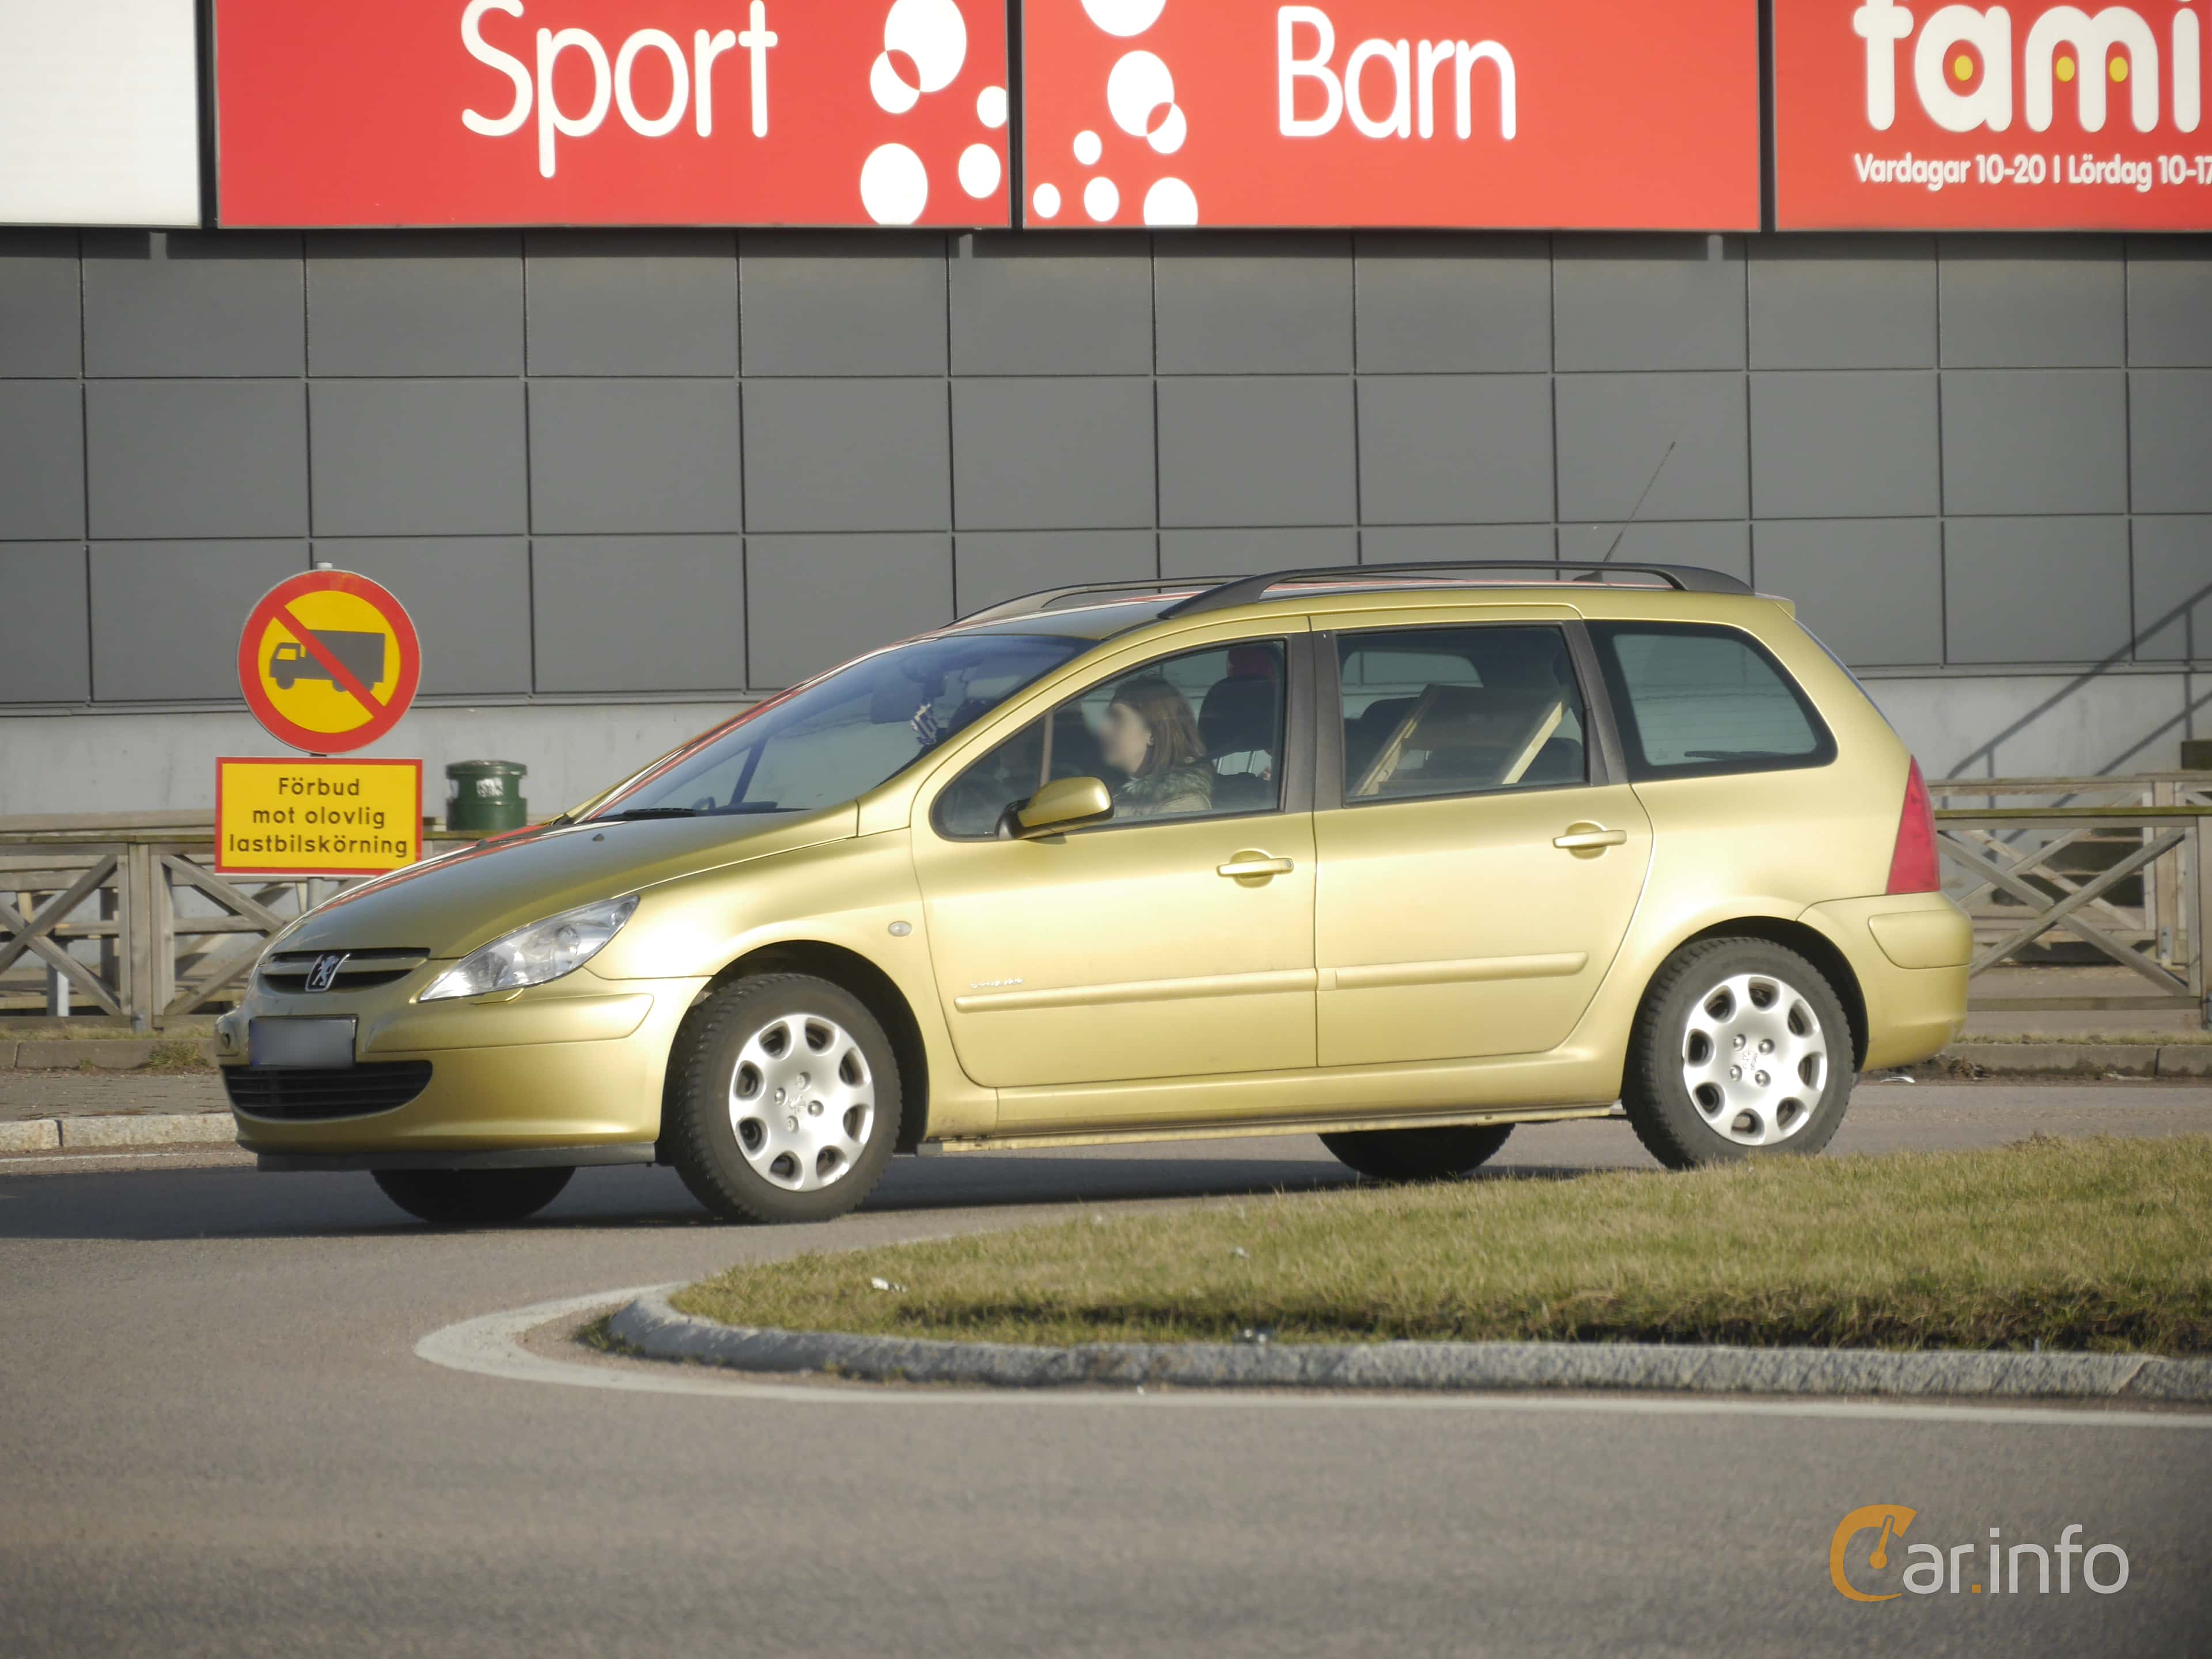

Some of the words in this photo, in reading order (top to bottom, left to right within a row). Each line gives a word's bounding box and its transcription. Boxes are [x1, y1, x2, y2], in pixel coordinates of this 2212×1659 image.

[460, 0, 779, 179] Sport
[1276, 5, 1517, 142] Barn
[1853, 151, 1972, 192] Vardagar
[1975, 153, 2047, 184] 10-20
[2067, 153, 2153, 192] Lördag
[2157, 154, 2212, 185] 10-17
[279, 777, 360, 796] Förbud
[253, 807, 296, 824] mot
[305, 806, 385, 830] olovlig
[230, 834, 407, 858] lastbilskörning
